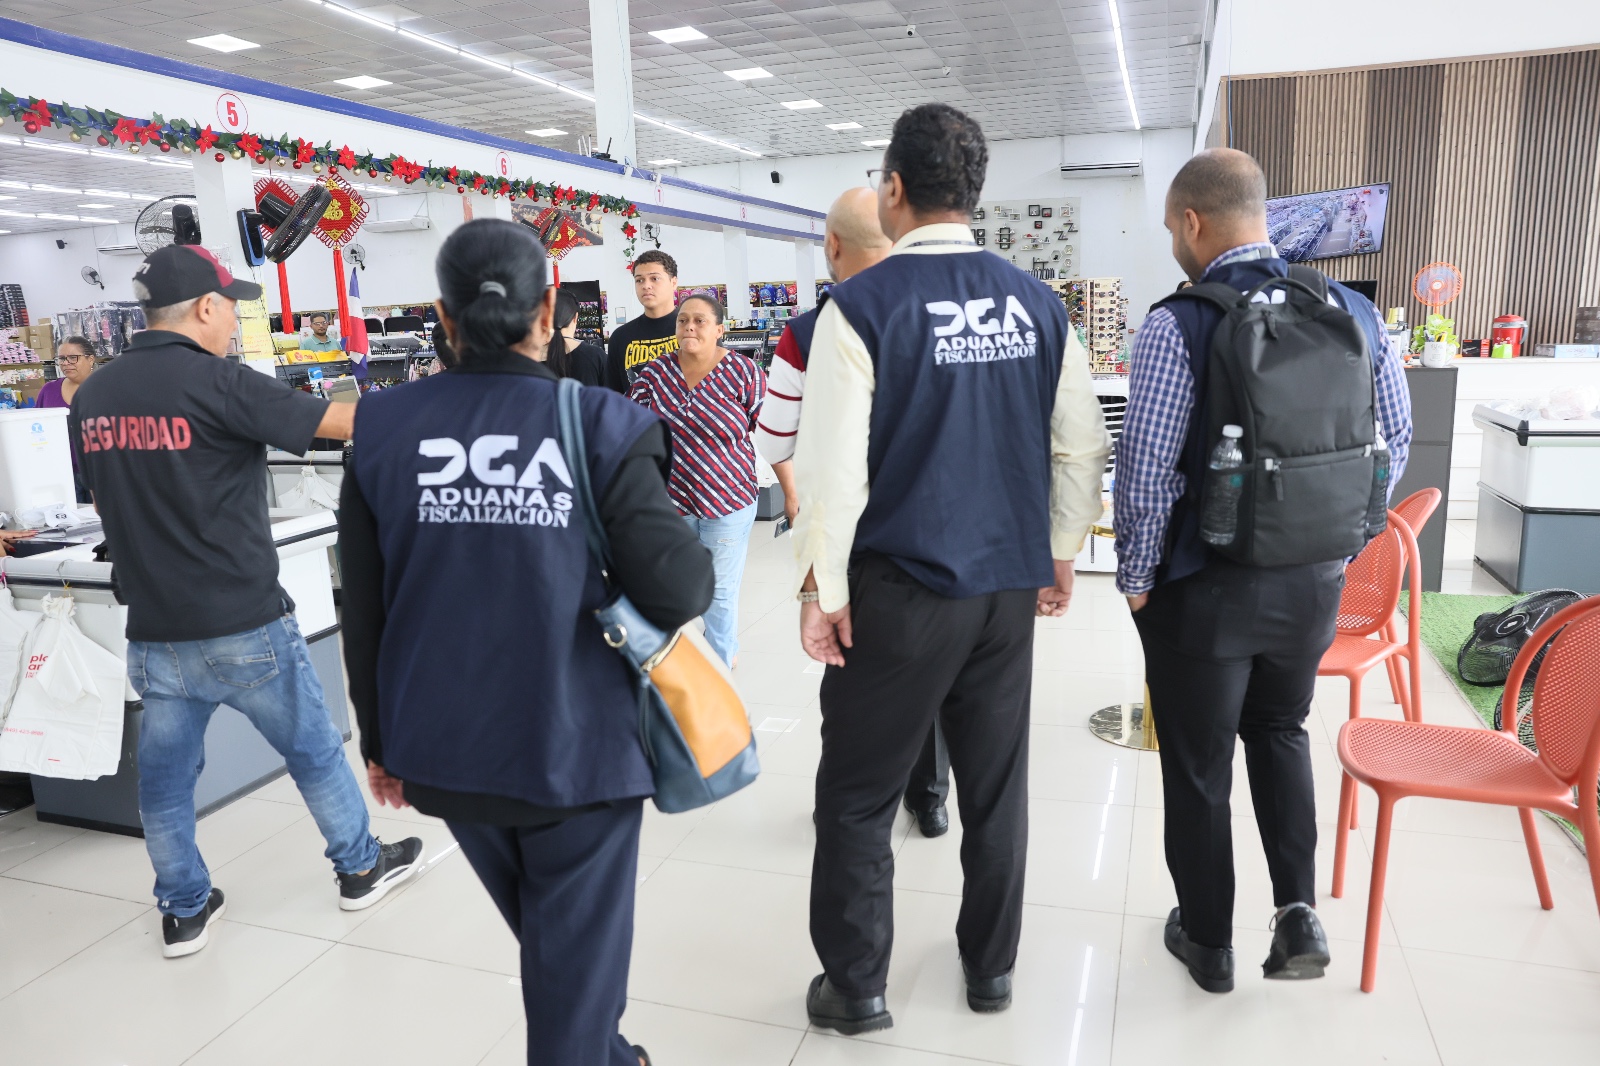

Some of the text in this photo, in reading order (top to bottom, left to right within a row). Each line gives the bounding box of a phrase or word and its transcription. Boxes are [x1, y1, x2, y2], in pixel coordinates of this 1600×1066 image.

[226, 101, 239, 127] 5
[501, 157, 507, 175] 6
[925, 294, 1035, 337] DGA
[934, 330, 1037, 353] ADUANAS
[934, 343, 1037, 366] FISCALIZACION
[81, 416, 192, 454] SEGURIDAD
[417, 434, 574, 490] DGA
[418, 487, 574, 512] ADUANAS
[417, 505, 571, 529] FISCALIZACION
